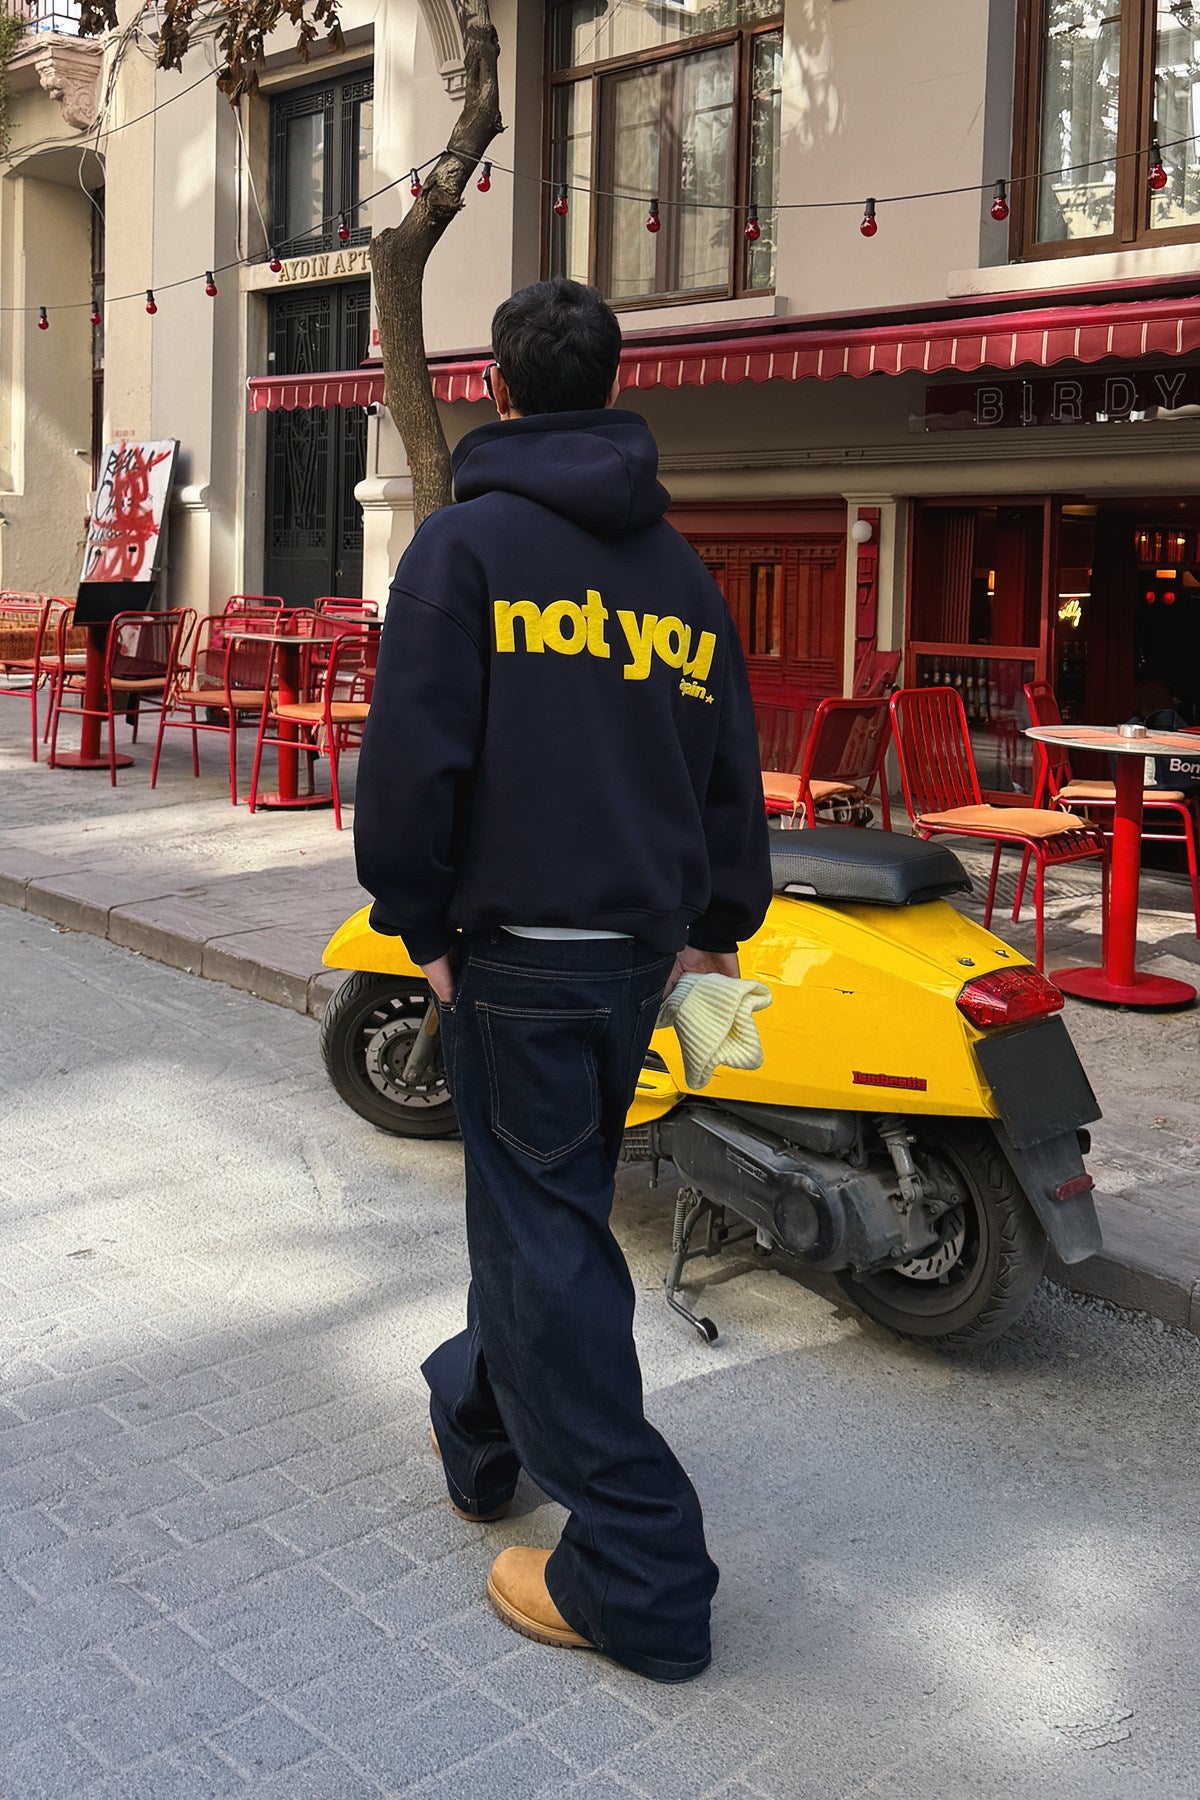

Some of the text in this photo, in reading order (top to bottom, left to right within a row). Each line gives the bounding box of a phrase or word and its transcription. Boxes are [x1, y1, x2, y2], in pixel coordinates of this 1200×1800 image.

[278, 254, 330, 282] AYDIN
[977, 373, 1186, 425] BIRDY
[494, 589, 716, 681] not you
